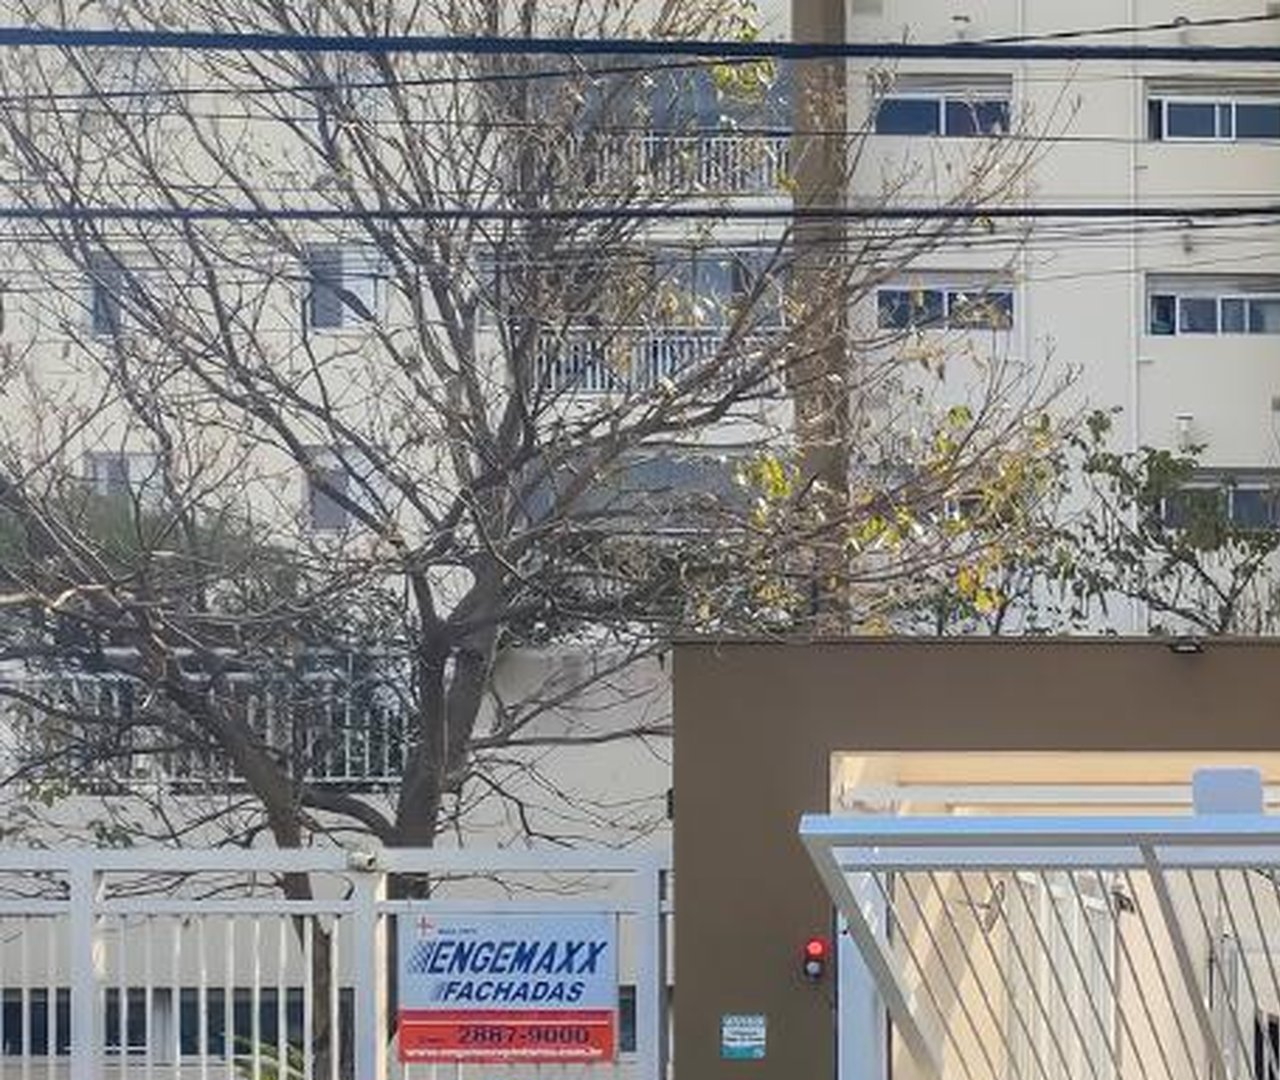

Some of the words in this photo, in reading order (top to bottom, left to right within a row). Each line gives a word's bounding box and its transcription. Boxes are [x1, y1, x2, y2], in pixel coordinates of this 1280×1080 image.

[428, 940, 607, 974] ENGEMAXX
[443, 981, 585, 1001] FACHADAS
[458, 1026, 589, 1044] 2887-9000
